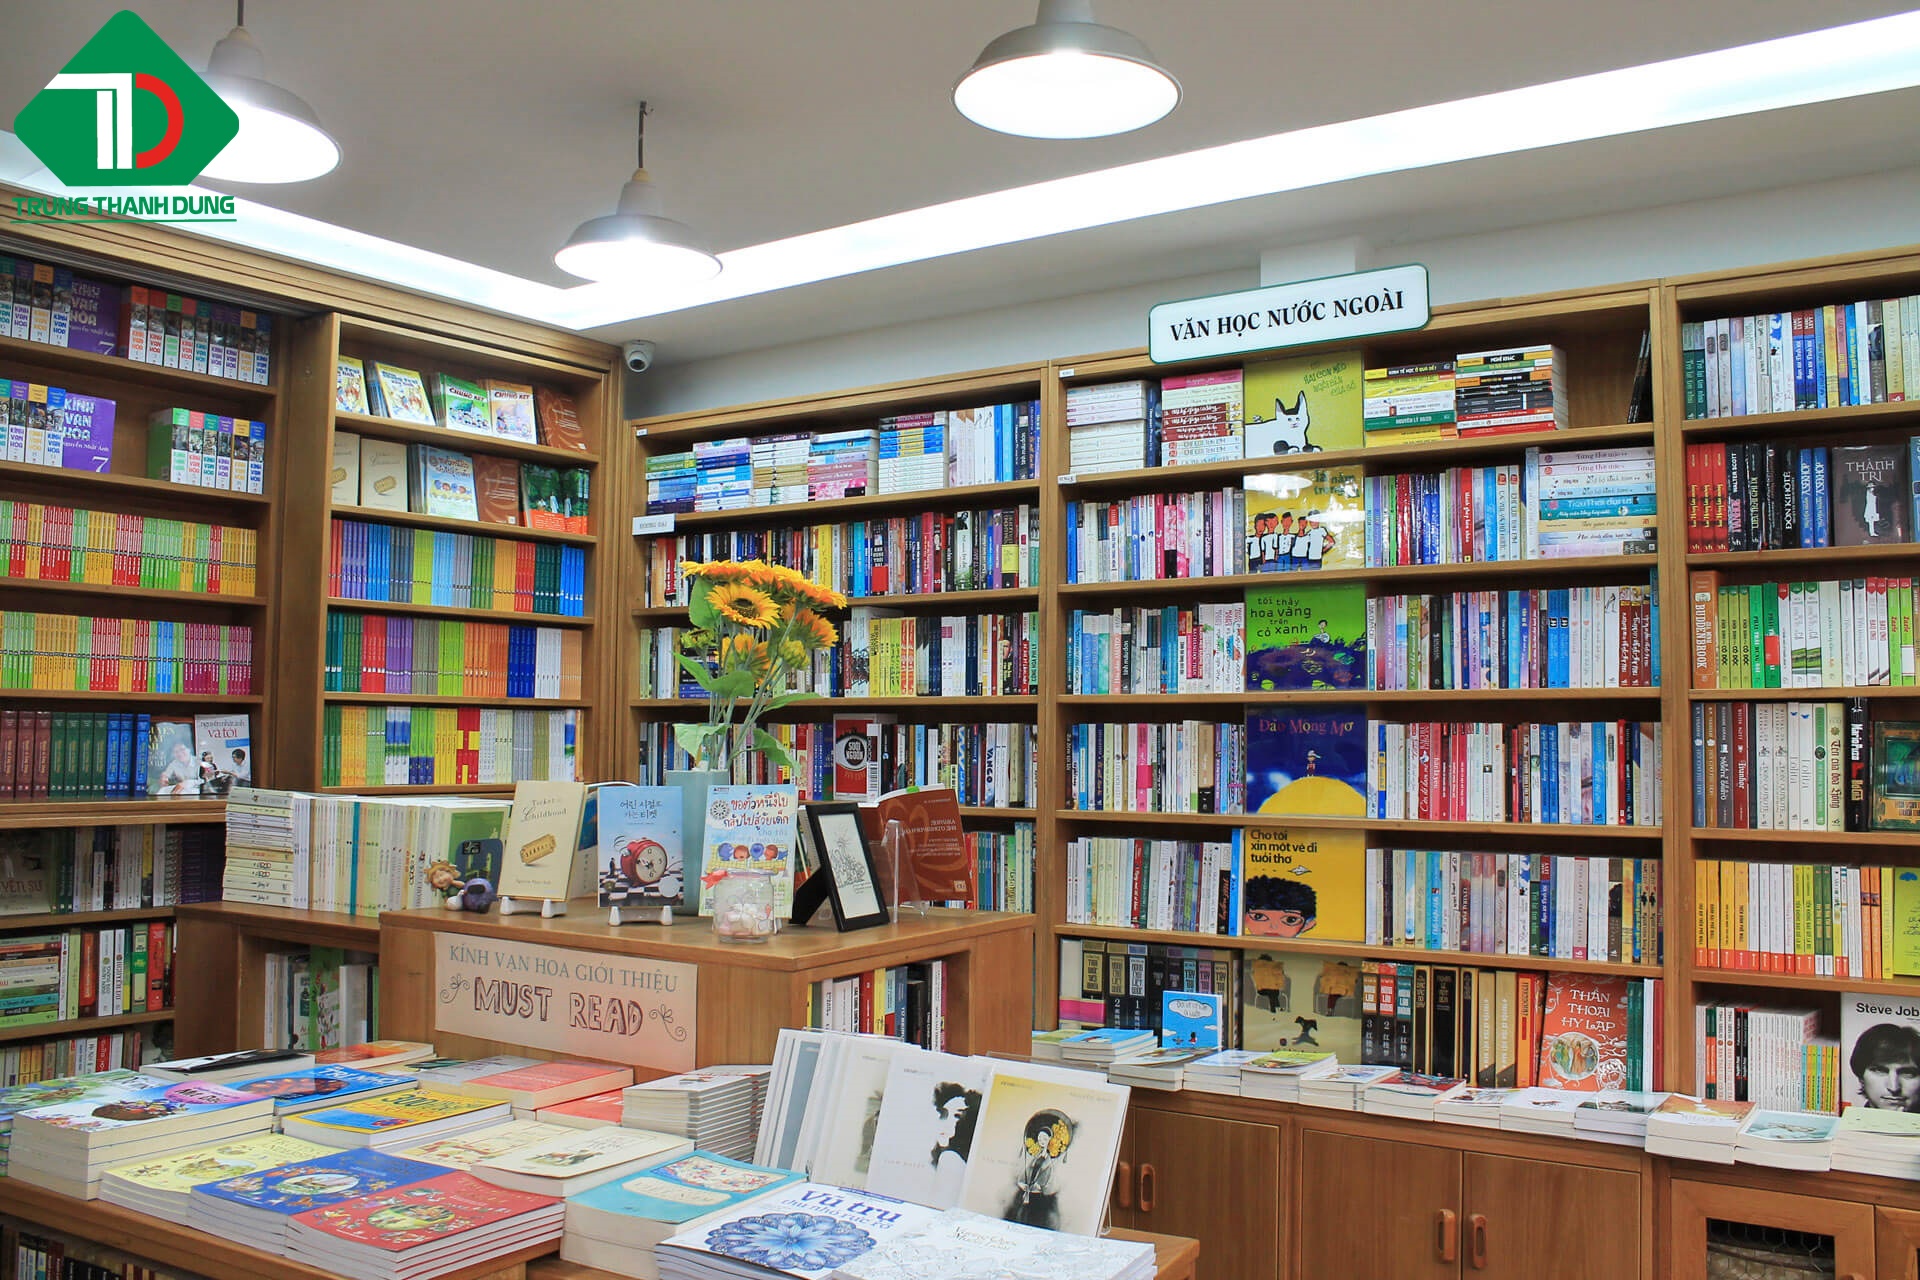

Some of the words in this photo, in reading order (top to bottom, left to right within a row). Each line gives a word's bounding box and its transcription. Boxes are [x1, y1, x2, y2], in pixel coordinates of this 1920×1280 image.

[1170, 317, 1210, 342] VĂN
[1218, 311, 1261, 336] HỌC
[1268, 299, 1327, 328] NƯỚC
[1334, 287, 1404, 318] NGOÀI
[98, 341, 115, 355] 7
[91, 456, 109, 473] 7
[1846, 456, 1896, 472] THÀNH
[1731, 471, 1739, 493] WALTER
[1258, 596, 1273, 606] tôi
[1276, 596, 1300, 609] thấy
[1250, 607, 1274, 618] hoa
[1277, 604, 1312, 621] vàng
[1257, 626, 1271, 638] cỏ
[1274, 623, 1308, 636] xanh
[1695, 604, 1708, 669] BUDDENBROOK
[223, 727, 238, 738] tôi
[1259, 718, 1287, 732] Đảo
[1290, 718, 1327, 735] Mộng
[1330, 720, 1355, 737] Mơ
[1851, 723, 1863, 744] Mario
[1789, 755, 1799, 784] Lolita
[1801, 758, 1810, 789] Lolita
[520, 807, 568, 823] Childhood
[1251, 830, 1271, 840] Cho
[1272, 830, 1288, 840] tôi
[1251, 841, 1267, 852] xin
[1268, 840, 1291, 853] một
[1292, 840, 1306, 853] vé
[1307, 841, 1318, 853] đi
[1251, 851, 1272, 863] tuổi
[1274, 852, 1292, 864] thơ
[450, 945, 489, 967] KÍNH
[494, 951, 530, 973] VẠN
[535, 957, 570, 978] HOA
[575, 961, 614, 986] GIỚI
[619, 967, 679, 994] THIỆU
[1569, 986, 1610, 1003] THẦN
[474, 976, 553, 1022] MUST
[569, 991, 644, 1037] READ
[1114, 1000, 1121, 1008] 2
[1567, 1003, 1611, 1018] THOẠI
[1856, 1001, 1893, 1015] Steve
[1896, 1004, 1920, 1018] Job
[1366, 1019, 1373, 1028] 3
[1383, 1021, 1390, 1030] 2
[1561, 1016, 1584, 1030] HY
[1586, 1016, 1616, 1032] LẠP
[801, 1190, 846, 1209] Vũ
